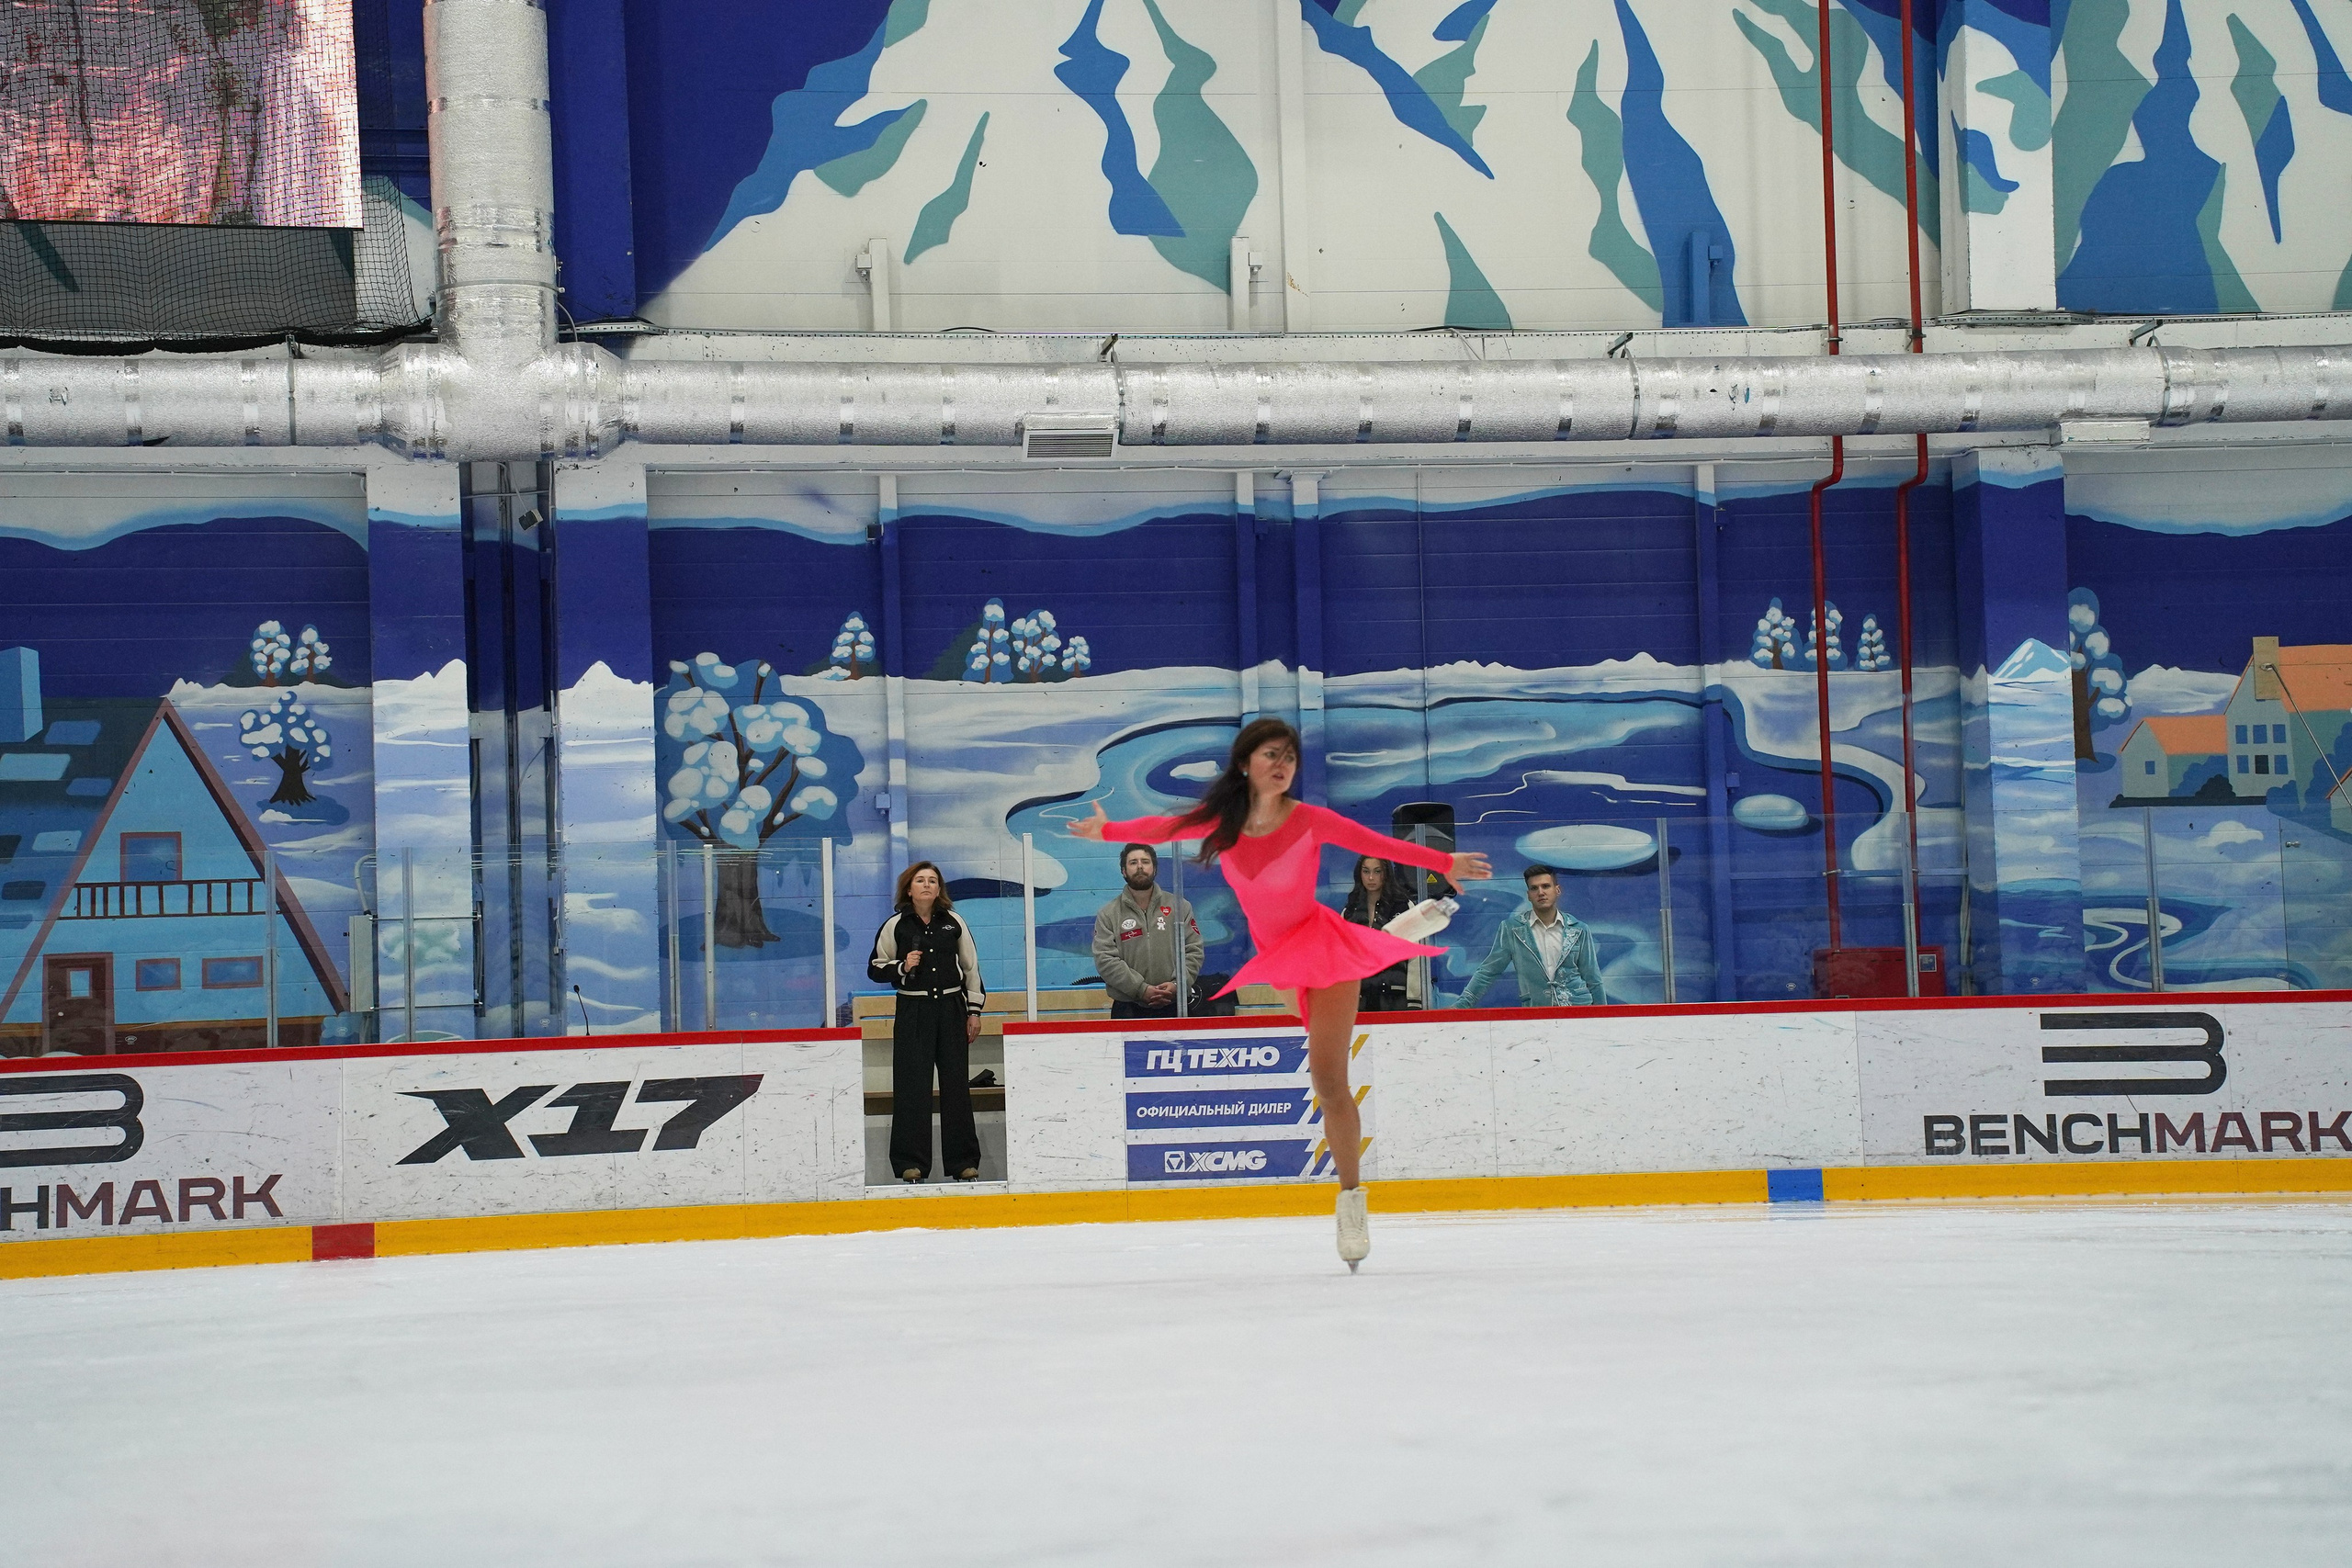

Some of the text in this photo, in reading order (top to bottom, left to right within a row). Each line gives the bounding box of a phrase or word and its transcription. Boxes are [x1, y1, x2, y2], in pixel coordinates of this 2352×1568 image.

[1147, 1045, 1281, 1073] ГЦ ТЕХНО
[395, 1073, 764, 1166] X17
[1136, 1100, 1292, 1119] ОФИЦИАЛЬНЫЙ ДИЛЕР
[1923, 1111, 2352, 1156] BENCHMARK
[1185, 1149, 1267, 1173] XCMG
